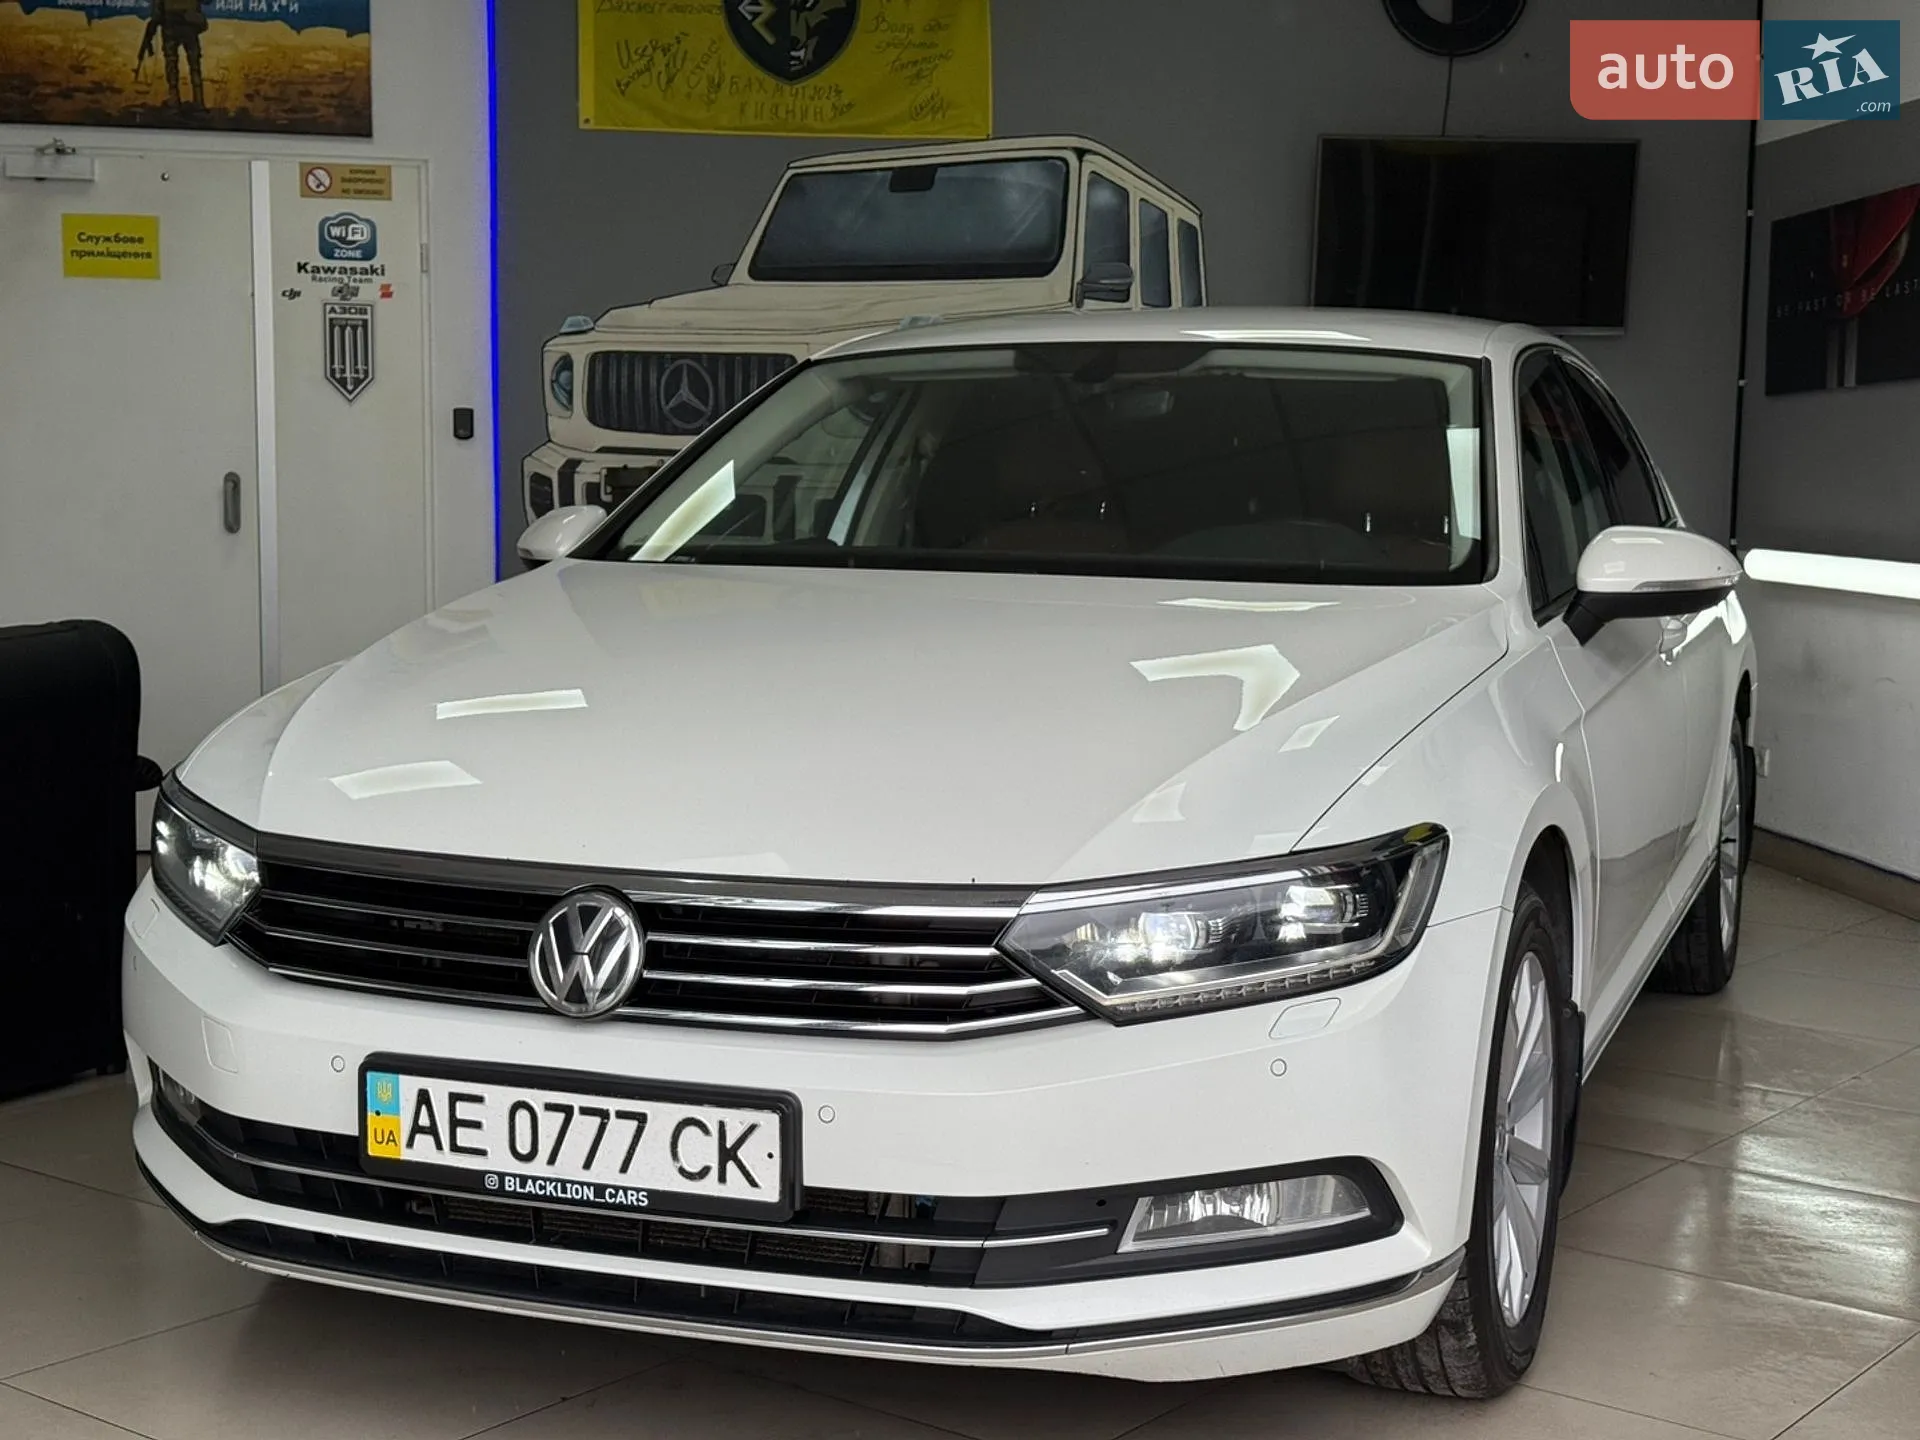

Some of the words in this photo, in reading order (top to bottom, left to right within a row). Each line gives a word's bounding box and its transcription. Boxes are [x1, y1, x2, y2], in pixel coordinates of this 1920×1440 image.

[77, 231, 145, 246] Службове
[70, 247, 153, 260] приміщення
[333, 248, 363, 259] ZONE
[296, 261, 386, 277] Kawasaki
[311, 275, 345, 285] Racing
[347, 276, 373, 285] Team
[373, 1128, 398, 1147] UA
[405, 1087, 489, 1157] AE
[508, 1099, 648, 1174] 0777
[670, 1116, 762, 1189] CK
[504, 1176, 649, 1208] BLACKLION_CARS
